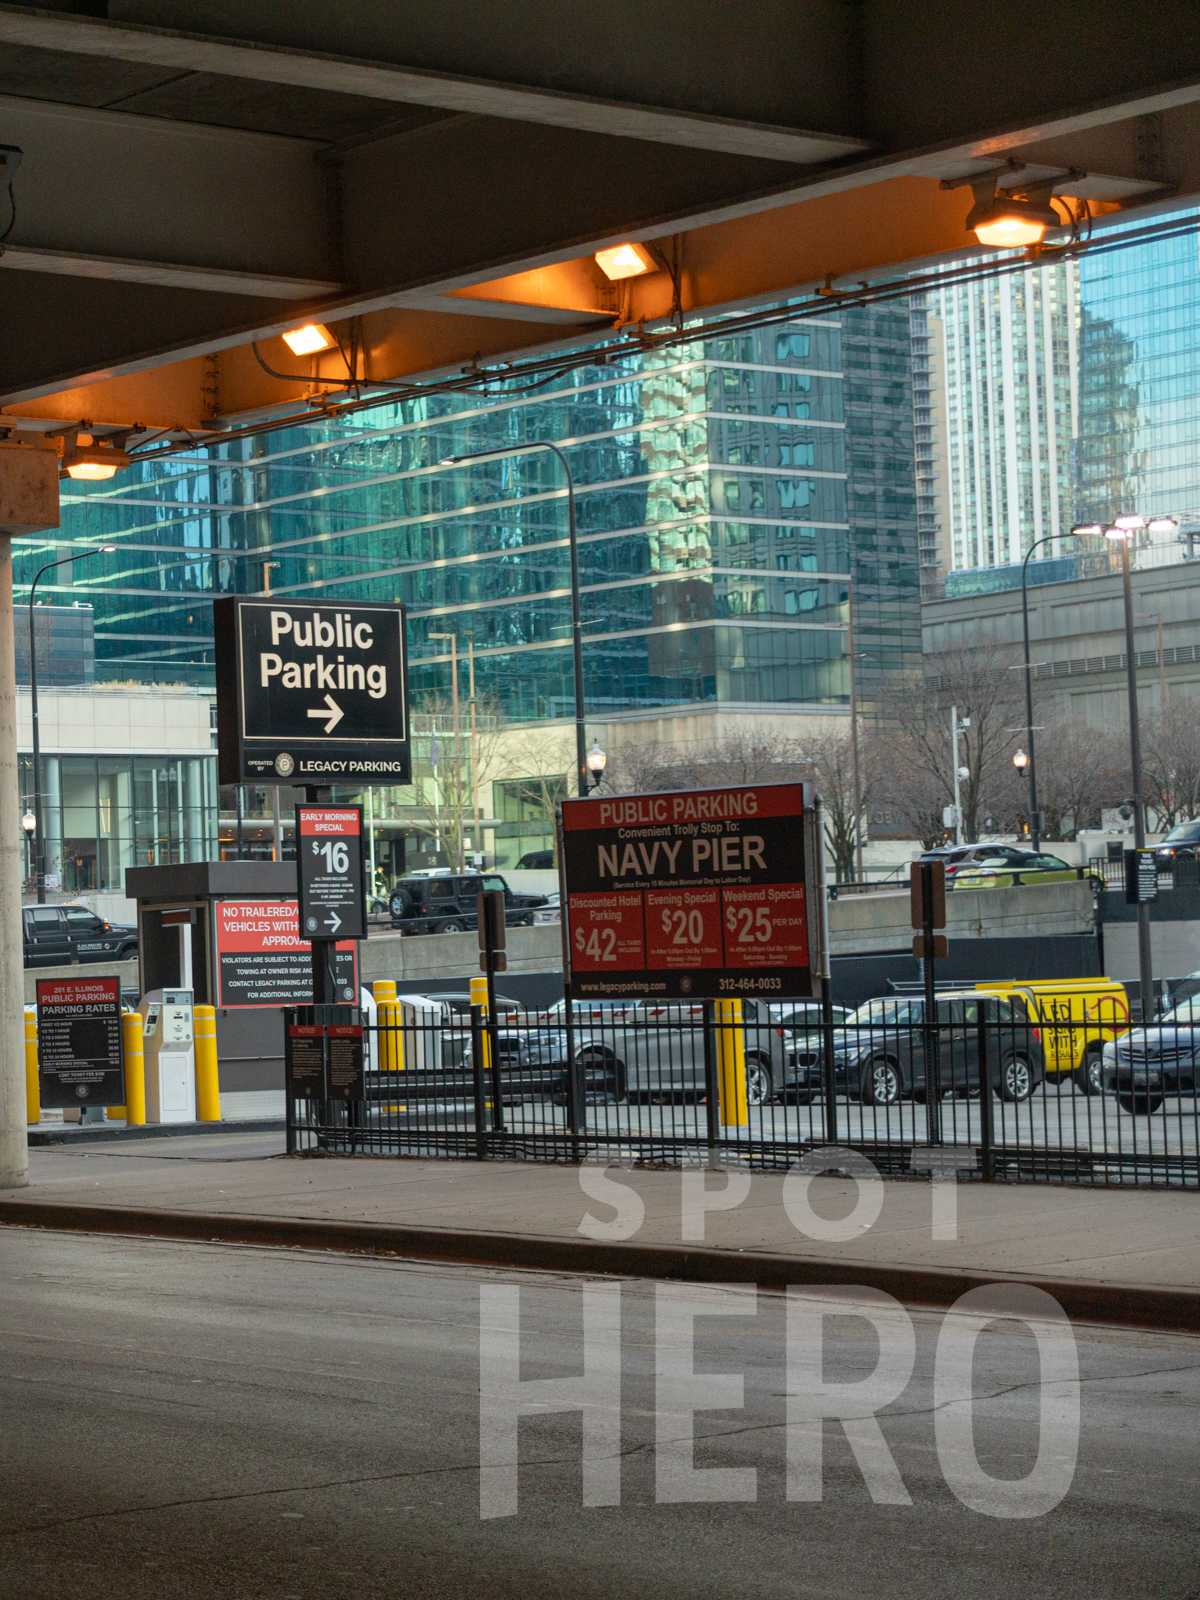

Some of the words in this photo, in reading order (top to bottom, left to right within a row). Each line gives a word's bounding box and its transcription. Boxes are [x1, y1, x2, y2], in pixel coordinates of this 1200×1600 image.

[270, 610, 374, 650] Public
[260, 652, 388, 699] Parking
[300, 760, 347, 772] LEGACY
[349, 761, 401, 772] PARKING
[601, 800, 667, 825] PUBLIC
[673, 792, 758, 820] PARKING
[300, 813, 323, 821] EARLY
[324, 813, 357, 821] MORNING
[314, 823, 345, 832] SPECIAL
[618, 824, 672, 839] Convenient
[673, 823, 698, 837] Trolly
[700, 822, 722, 836] Stop
[725, 820, 740, 832] To:
[312, 840, 350, 874] $16
[598, 841, 682, 878] NAVY
[693, 835, 768, 873] PIER
[570, 896, 617, 909] Discounted
[619, 895, 641, 907] Hotel
[648, 893, 683, 906] Evening
[684, 891, 717, 905] Special
[723, 889, 766, 902] Weekend
[768, 888, 803, 903] Special
[223, 906, 238, 917] NO
[590, 910, 623, 922] Parking
[224, 921, 271, 932] VEHICLES
[662, 908, 704, 944] $20
[726, 906, 772, 942] $25
[576, 927, 617, 961] $42
[222, 956, 252, 964] VIOLATORS
[75, 985, 104, 993] ILLINOIS
[228, 980, 254, 988] CONTACT
[719, 978, 782, 990] 312-464-0033
[42, 994, 74, 1003] PUBLIC
[76, 992, 116, 1002] PARKING
[42, 1004, 84, 1014] PARKING
[85, 1003, 116, 1012] RATES
